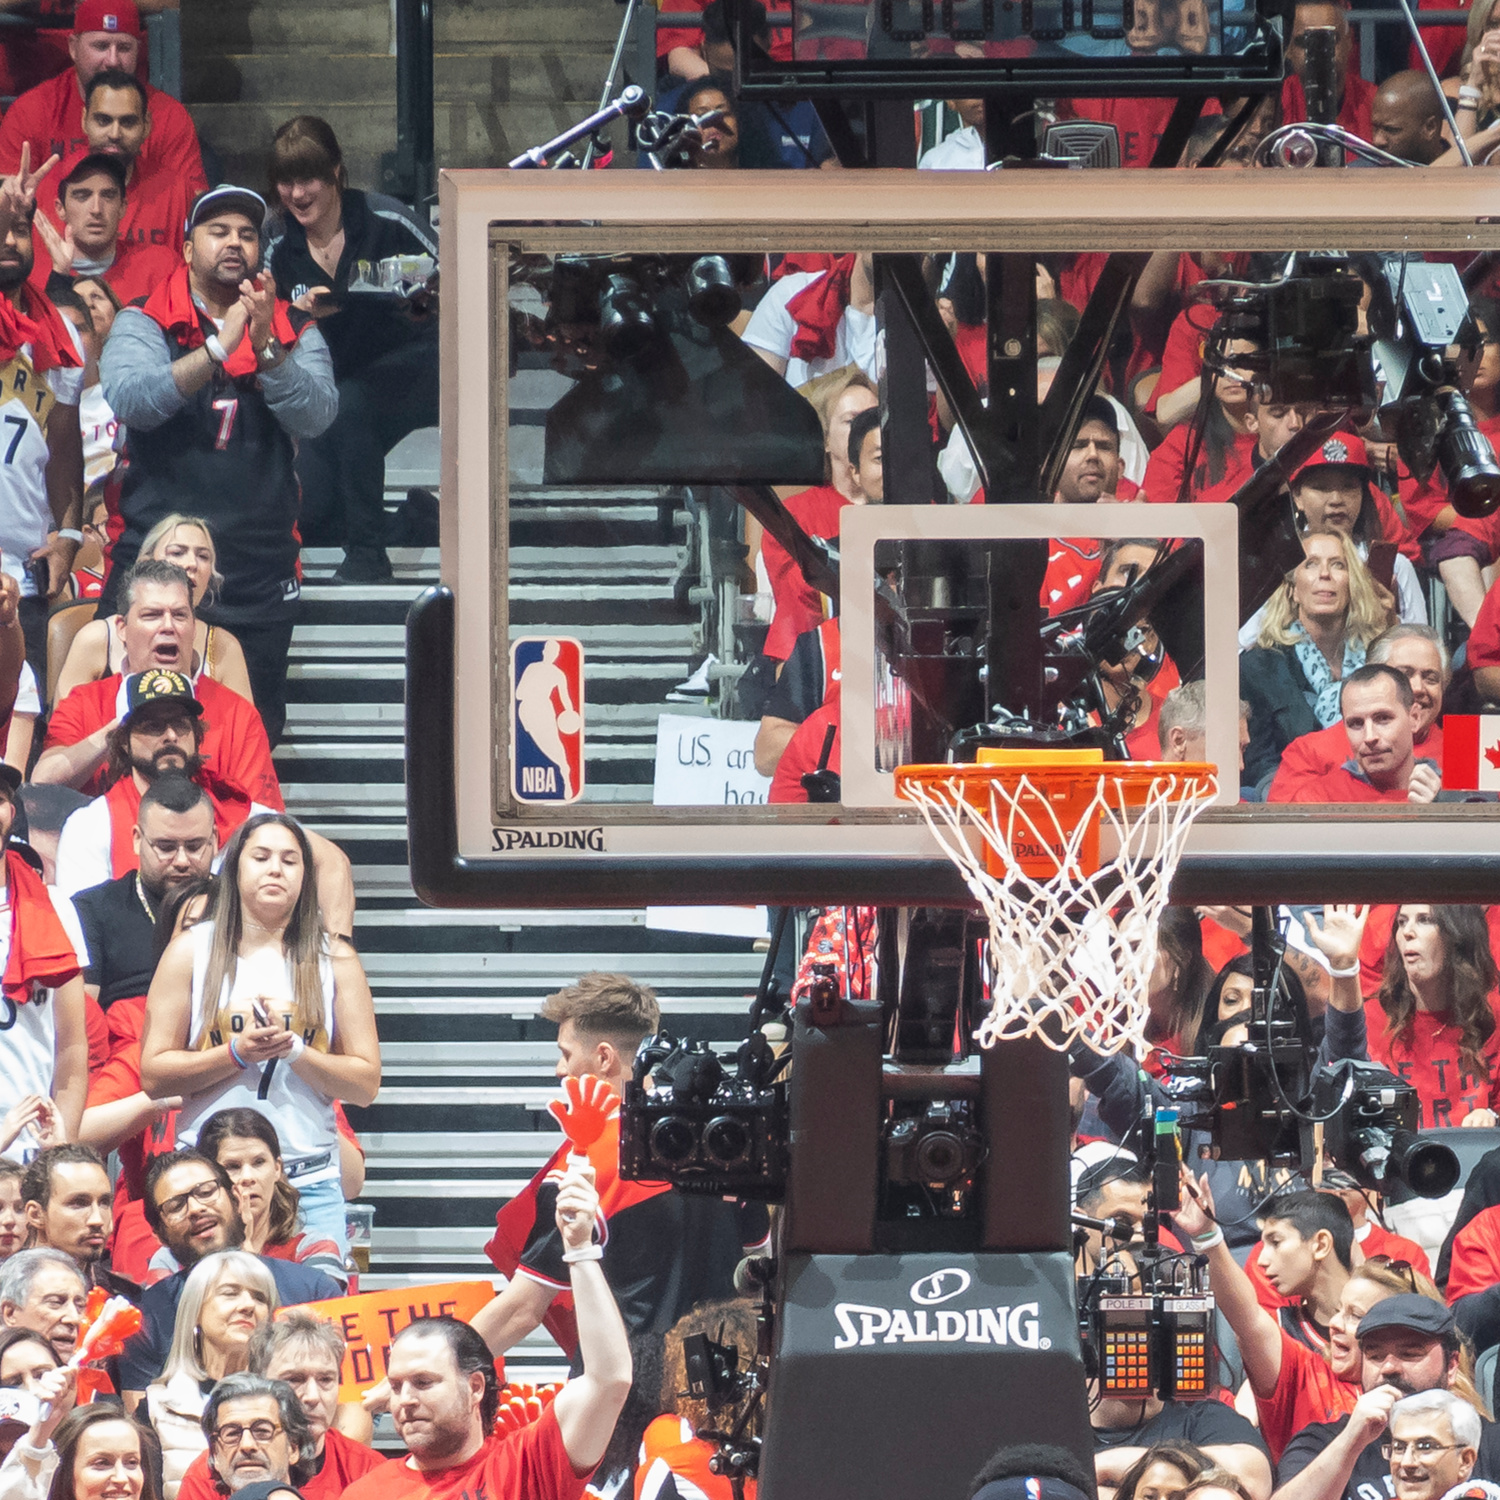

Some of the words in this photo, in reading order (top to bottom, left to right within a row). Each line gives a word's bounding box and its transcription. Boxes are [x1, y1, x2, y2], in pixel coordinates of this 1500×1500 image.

[212, 399, 239, 450] 7
[522, 766, 556, 793] NBA
[491, 827, 605, 852] SPALDING
[210, 1014, 317, 1048] NOTH
[1105, 1300, 1136, 1309] POLE
[834, 1303, 1039, 1350] SPALDING
